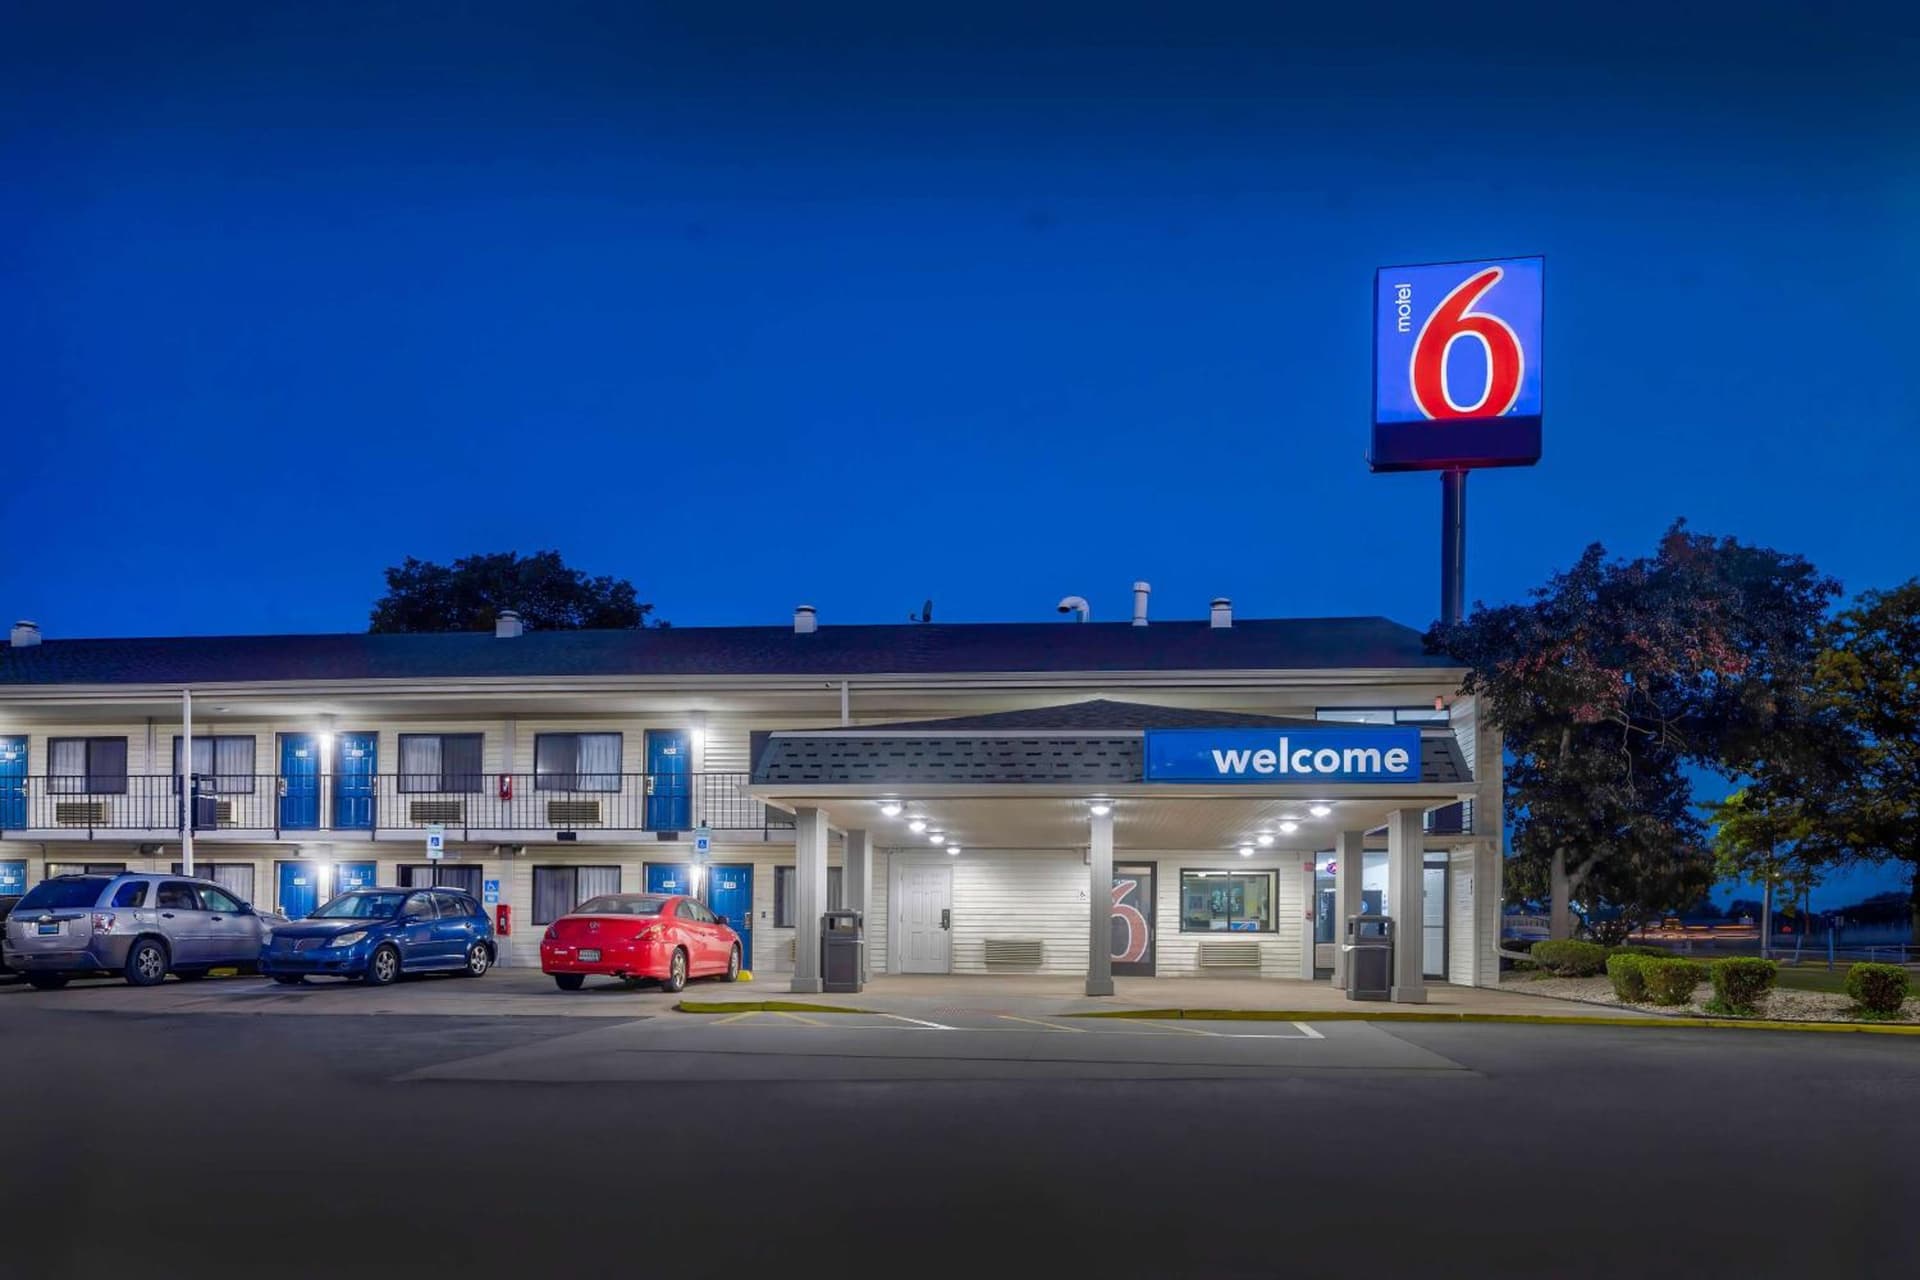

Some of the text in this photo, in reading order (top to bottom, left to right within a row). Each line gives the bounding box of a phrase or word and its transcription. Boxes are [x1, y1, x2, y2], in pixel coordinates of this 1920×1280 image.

[1395, 266, 1525, 420] motel 6
[1211, 737, 1409, 774] welcome
